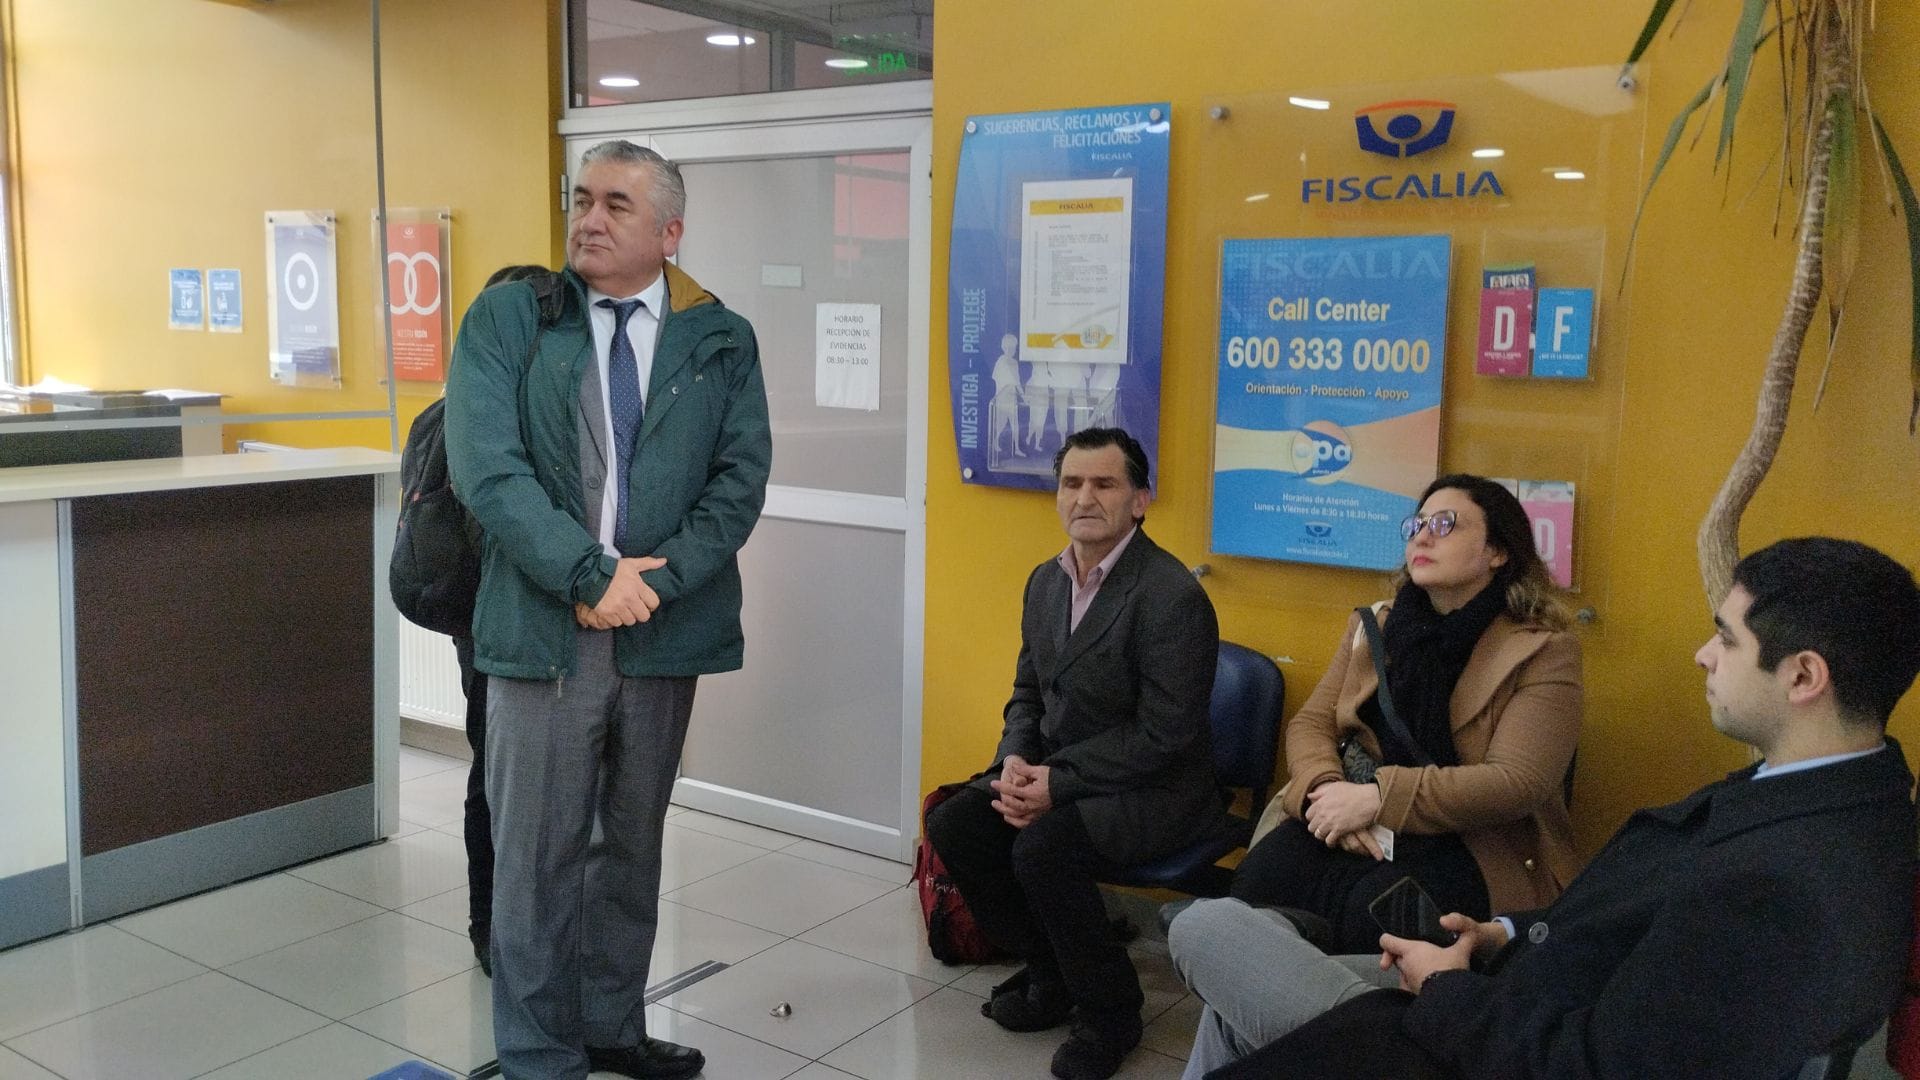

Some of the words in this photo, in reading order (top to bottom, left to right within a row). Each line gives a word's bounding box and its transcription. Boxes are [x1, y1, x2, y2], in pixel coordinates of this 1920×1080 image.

[1064, 112, 1130, 130] RECLAMOS
[1133, 110, 1143, 127] Y
[1053, 129, 1142, 148] FELICITACIONES
[1091, 152, 1132, 161] FISCALIA
[1302, 170, 1505, 203] FISCALIA
[1059, 202, 1094, 210] FISCALIA
[1225, 250, 1443, 281] FISCALIA
[834, 315, 864, 324] HORARIO
[1268, 297, 1309, 321] Call
[1315, 298, 1390, 322] Center
[963, 287, 981, 353] PROTEGE
[1493, 306, 1515, 351] D
[1553, 306, 1574, 352] F
[862, 329, 870, 337] DE
[830, 342, 867, 351] EVIDENCIAS
[1227, 336, 1280, 369] 600
[1288, 337, 1343, 371] 333
[1352, 338, 1431, 373] 0000
[1246, 382, 1302, 395] Orientación
[1311, 384, 1365, 397] Protección
[1375, 387, 1409, 400] Apoyo
[961, 373, 979, 449] INVESTIGA
[1282, 492, 1313, 504] Horarios
[1315, 496, 1324, 505] de
[1326, 496, 1360, 508] Atención
[1254, 501, 1276, 512] Lunes
[1282, 504, 1309, 515] Viernes
[1310, 506, 1321, 516] de
[1367, 511, 1390, 522] horas
